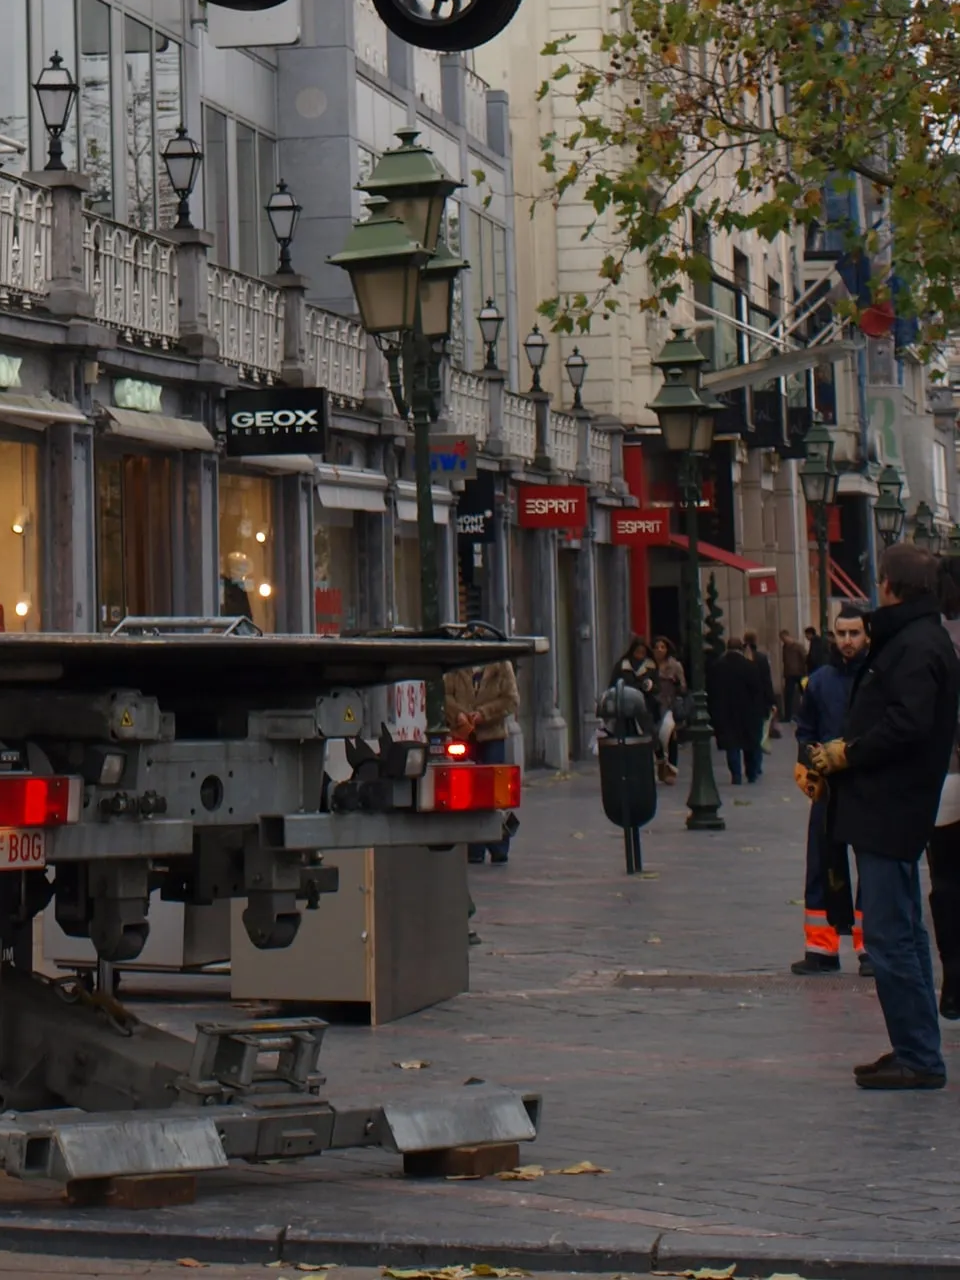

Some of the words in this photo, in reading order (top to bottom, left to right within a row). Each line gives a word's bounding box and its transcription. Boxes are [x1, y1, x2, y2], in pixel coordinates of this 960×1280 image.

[231, 409, 319, 428] GEOX
[231, 426, 320, 436] RESPIRA
[525, 499, 579, 515] ESPRIT
[616, 520, 662, 535] ESPRIT
